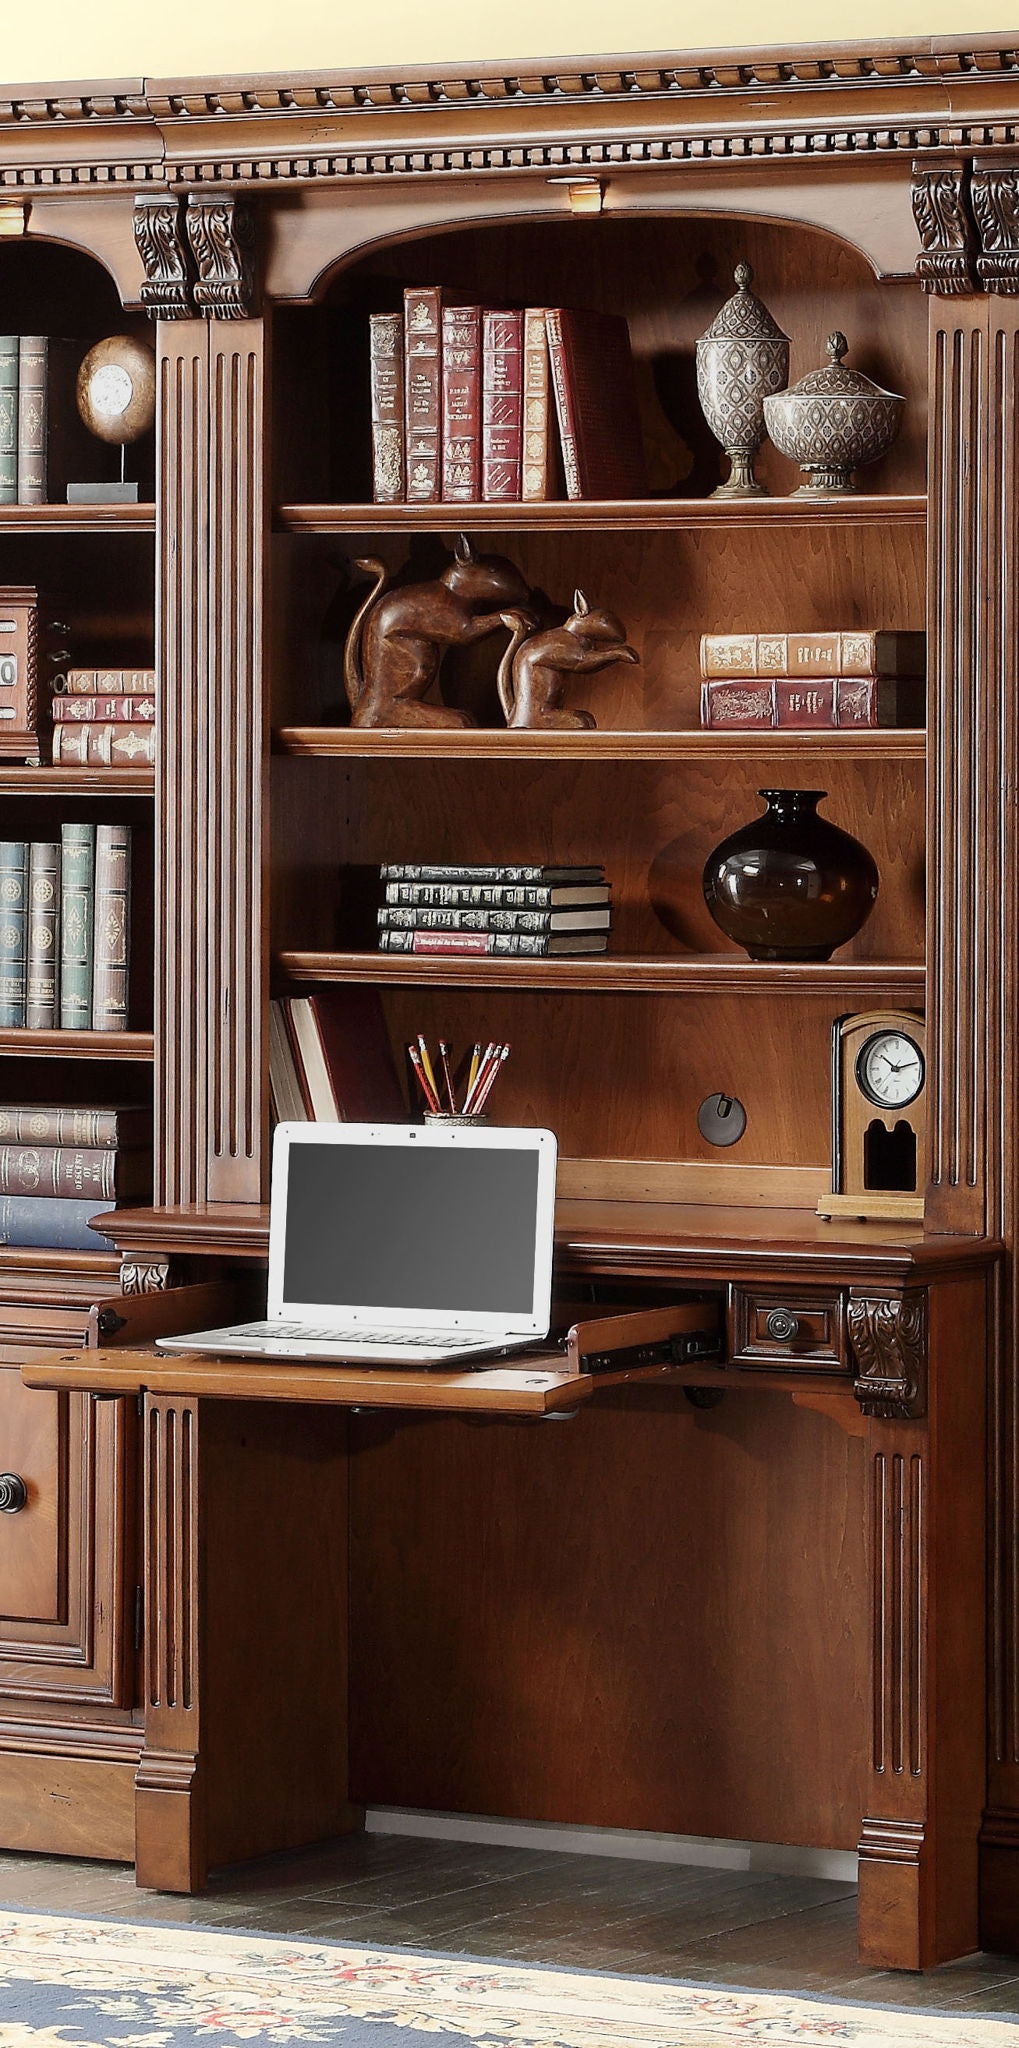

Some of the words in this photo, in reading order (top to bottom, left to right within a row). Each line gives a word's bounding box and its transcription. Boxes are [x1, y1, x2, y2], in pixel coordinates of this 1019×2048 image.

[65, 1164, 74, 1178] THE
[74, 1153, 83, 1190] DESCENT
[83, 1167, 91, 1178] OF
[92, 1162, 101, 1182] MAN
